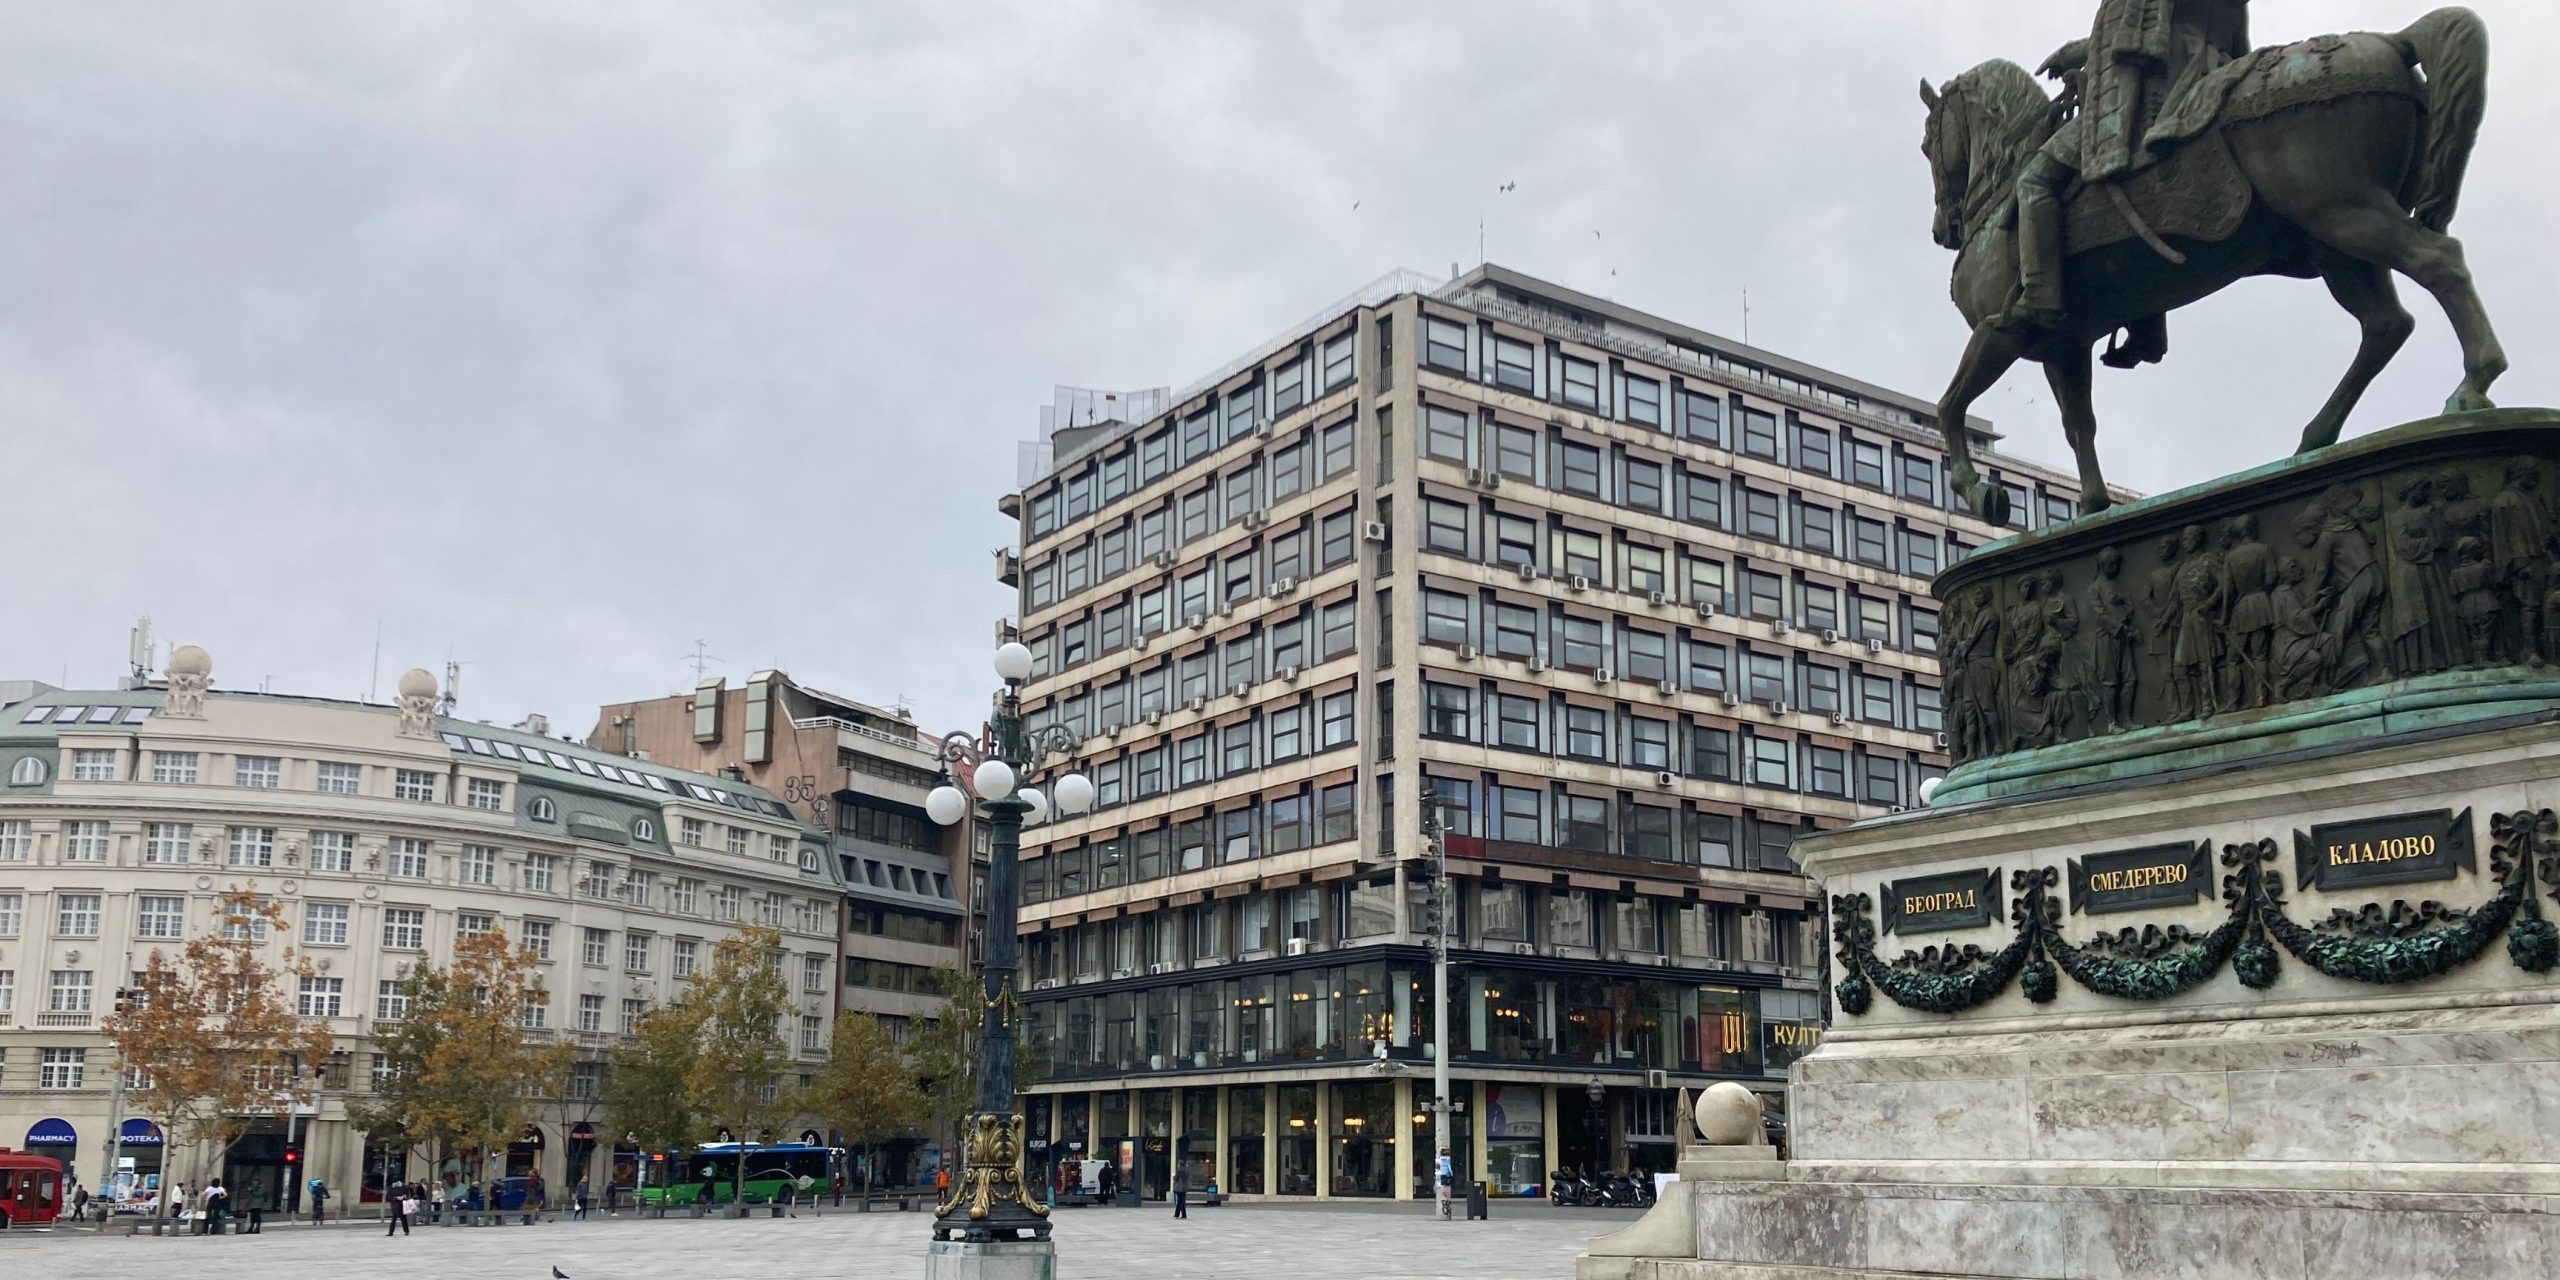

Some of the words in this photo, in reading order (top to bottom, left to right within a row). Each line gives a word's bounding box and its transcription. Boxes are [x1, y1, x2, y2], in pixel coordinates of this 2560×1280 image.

[2329, 835, 2435, 866] КЛАДОВО
[2090, 863, 2188, 892] СМЕДЕРЕВО
[1905, 889, 1976, 915] БЕОГРАД
